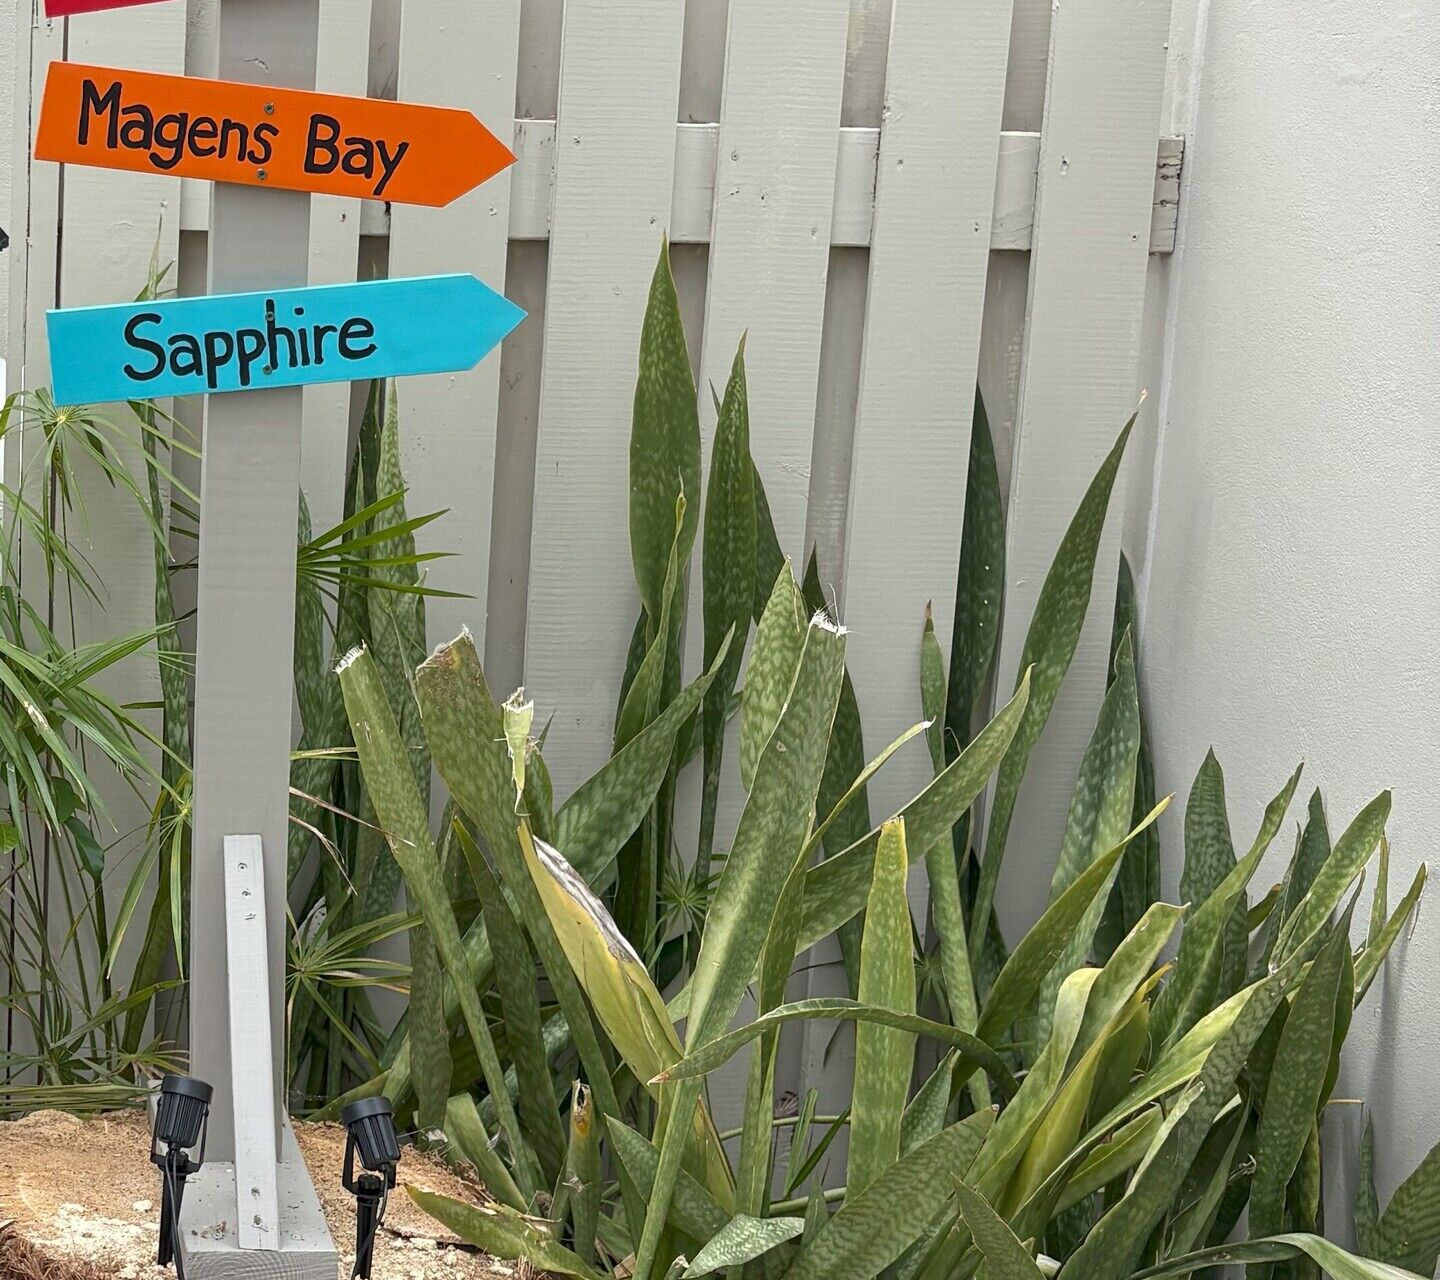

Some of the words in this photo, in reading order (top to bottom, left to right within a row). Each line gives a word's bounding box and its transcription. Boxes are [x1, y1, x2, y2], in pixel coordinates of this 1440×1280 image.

[77, 79, 279, 171] Magens
[303, 113, 410, 196] Bay
[123, 298, 378, 389] Sapphire
